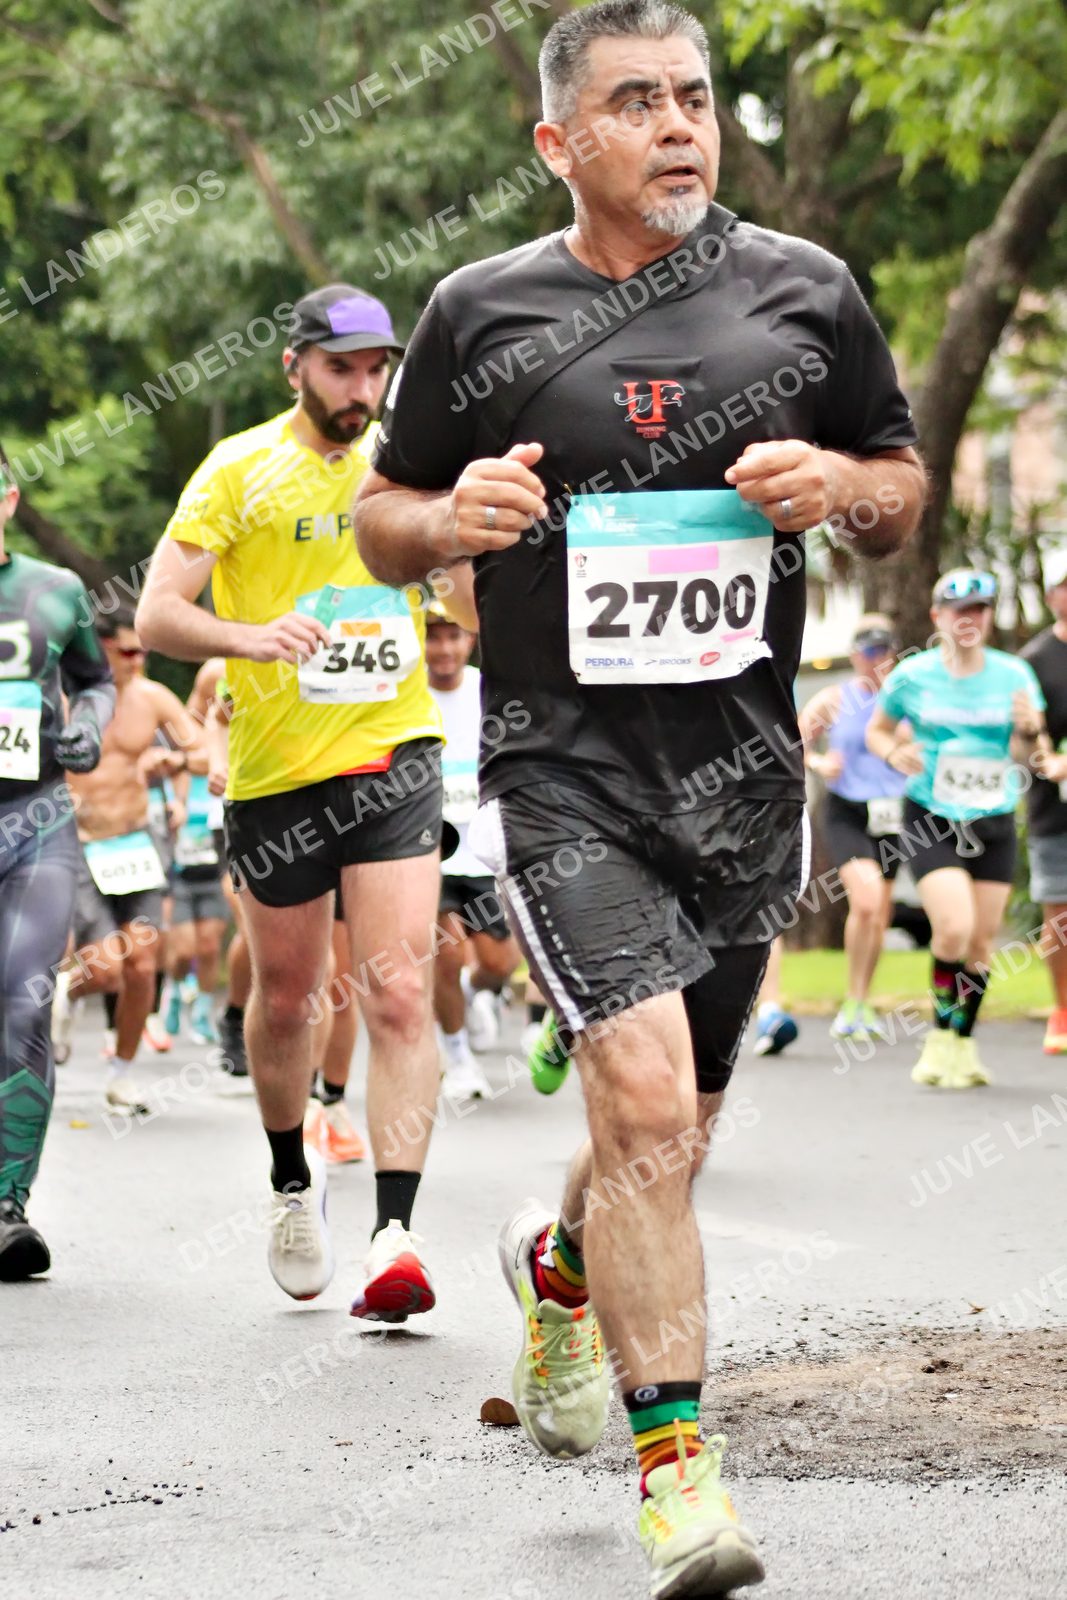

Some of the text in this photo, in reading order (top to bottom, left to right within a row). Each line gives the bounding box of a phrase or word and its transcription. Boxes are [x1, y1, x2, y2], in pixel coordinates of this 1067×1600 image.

[584, 574, 756, 638] 2700
[322, 639, 400, 673] 346
[584, 657, 634, 667] PERDURA
[659, 657, 692, 666] BROOKS
[0, 725, 31, 754] 24
